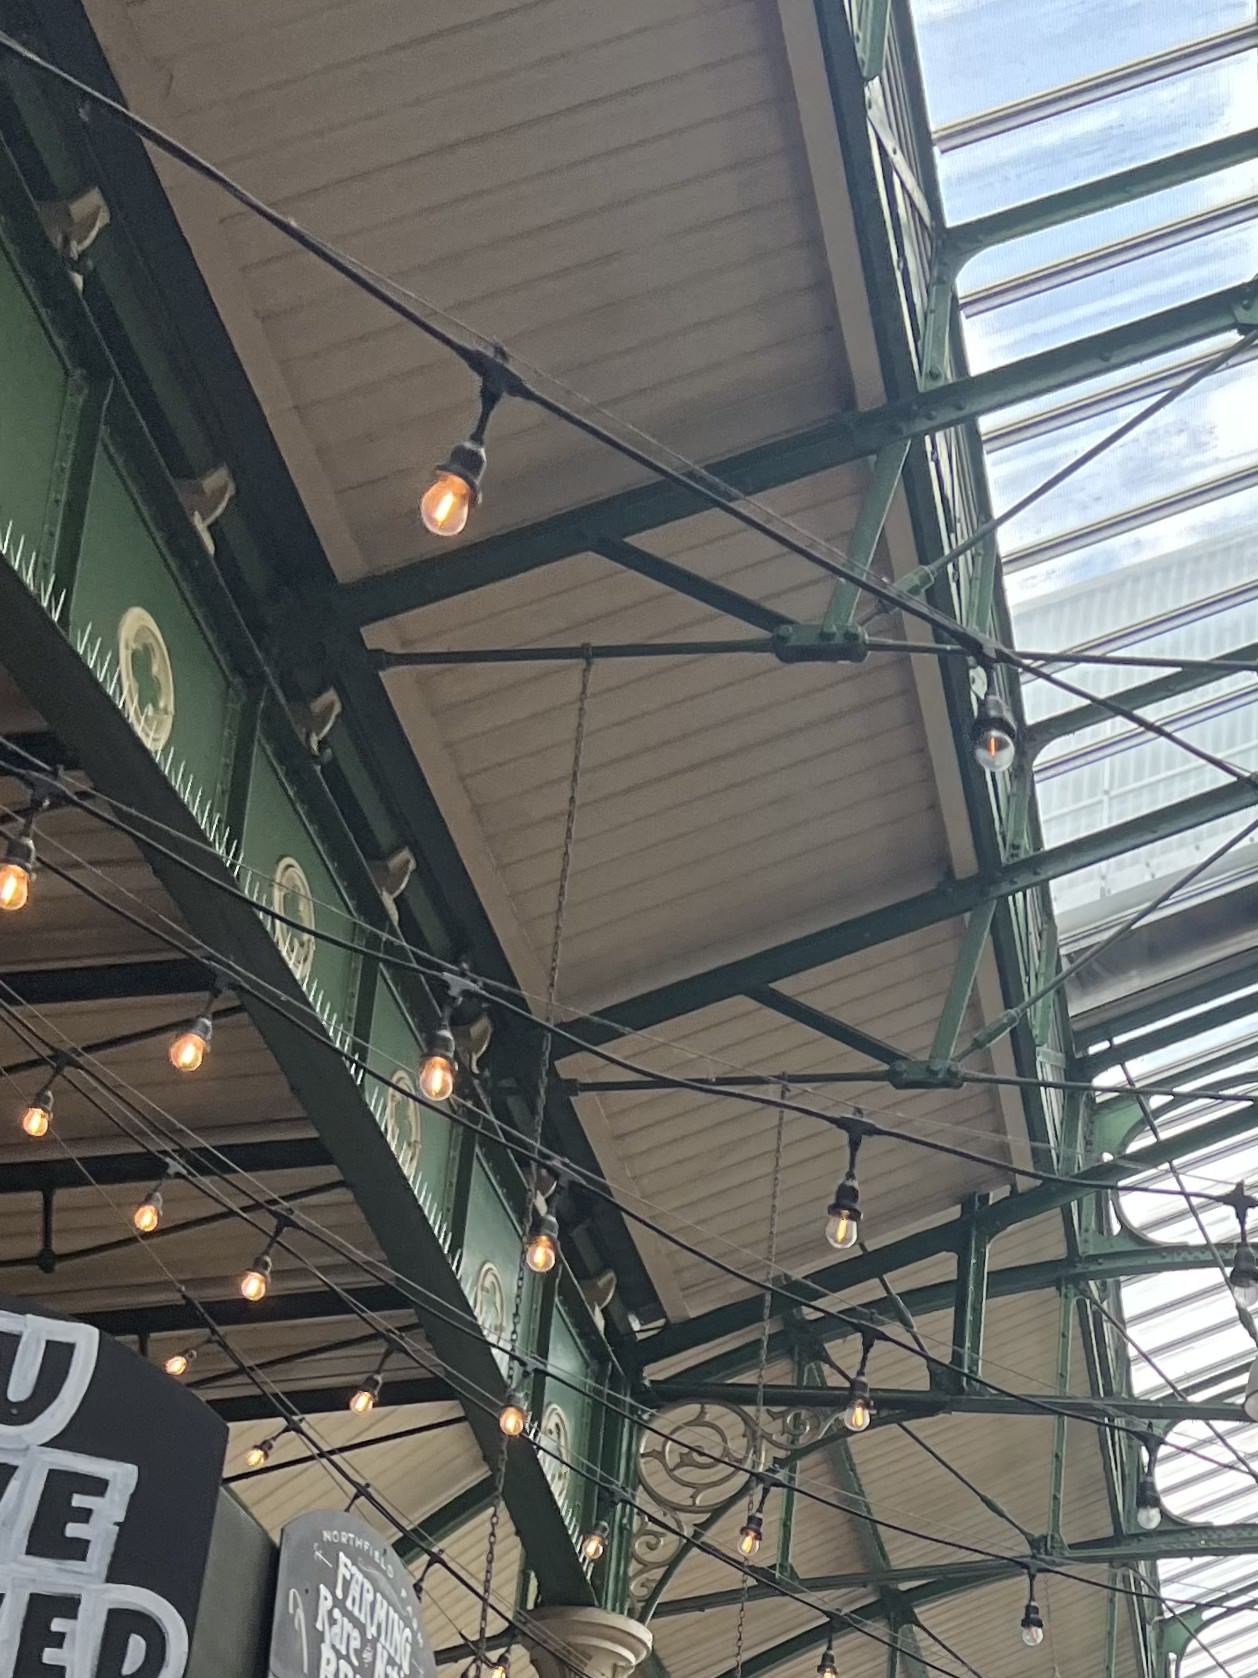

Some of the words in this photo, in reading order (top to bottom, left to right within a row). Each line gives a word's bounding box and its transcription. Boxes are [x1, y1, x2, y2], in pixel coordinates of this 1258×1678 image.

[322, 1529, 394, 1579] NORTHFIELD
[315, 1583, 362, 1667] Rare
[335, 1551, 412, 1676] FARMING
